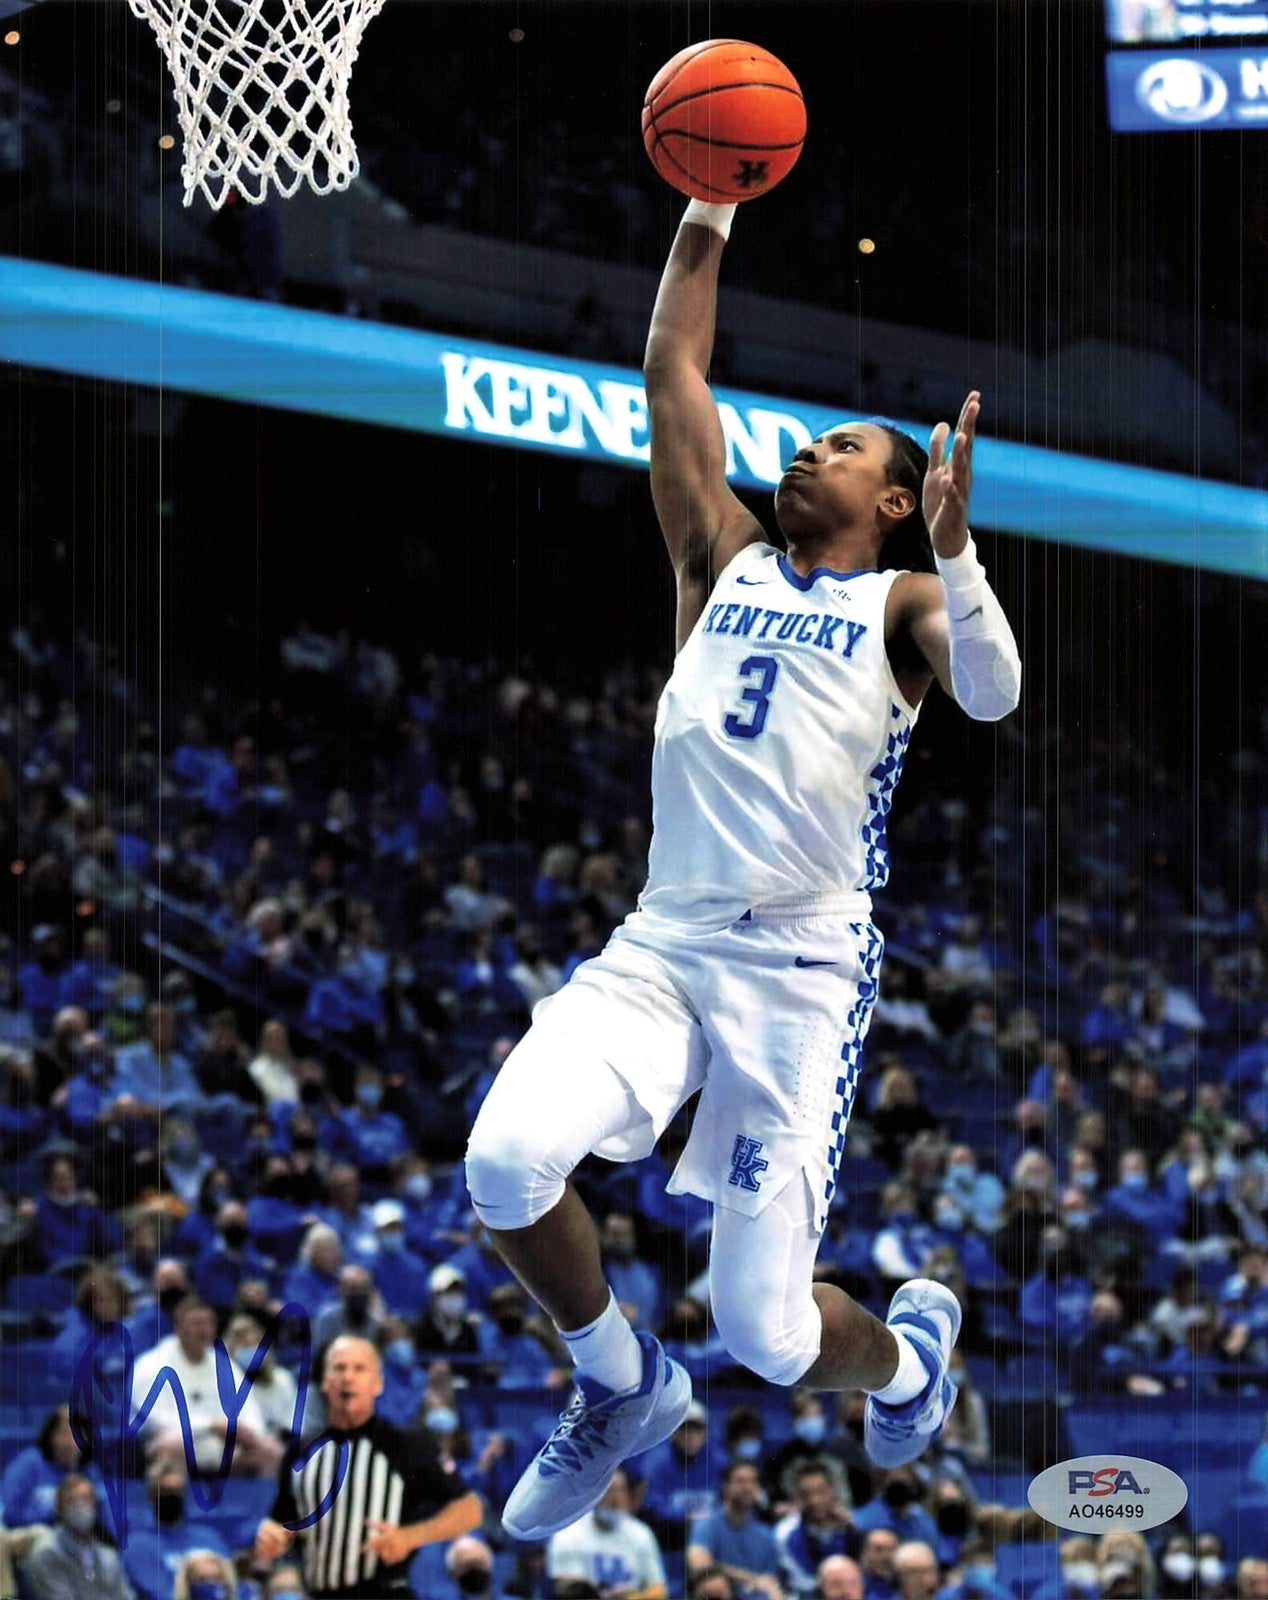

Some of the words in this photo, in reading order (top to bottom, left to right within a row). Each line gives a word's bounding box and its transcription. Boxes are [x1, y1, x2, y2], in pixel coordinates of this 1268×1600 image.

[440, 351, 814, 485] KEENEND
[703, 603, 868, 658] KENTUCKY
[724, 656, 778, 739] 3
